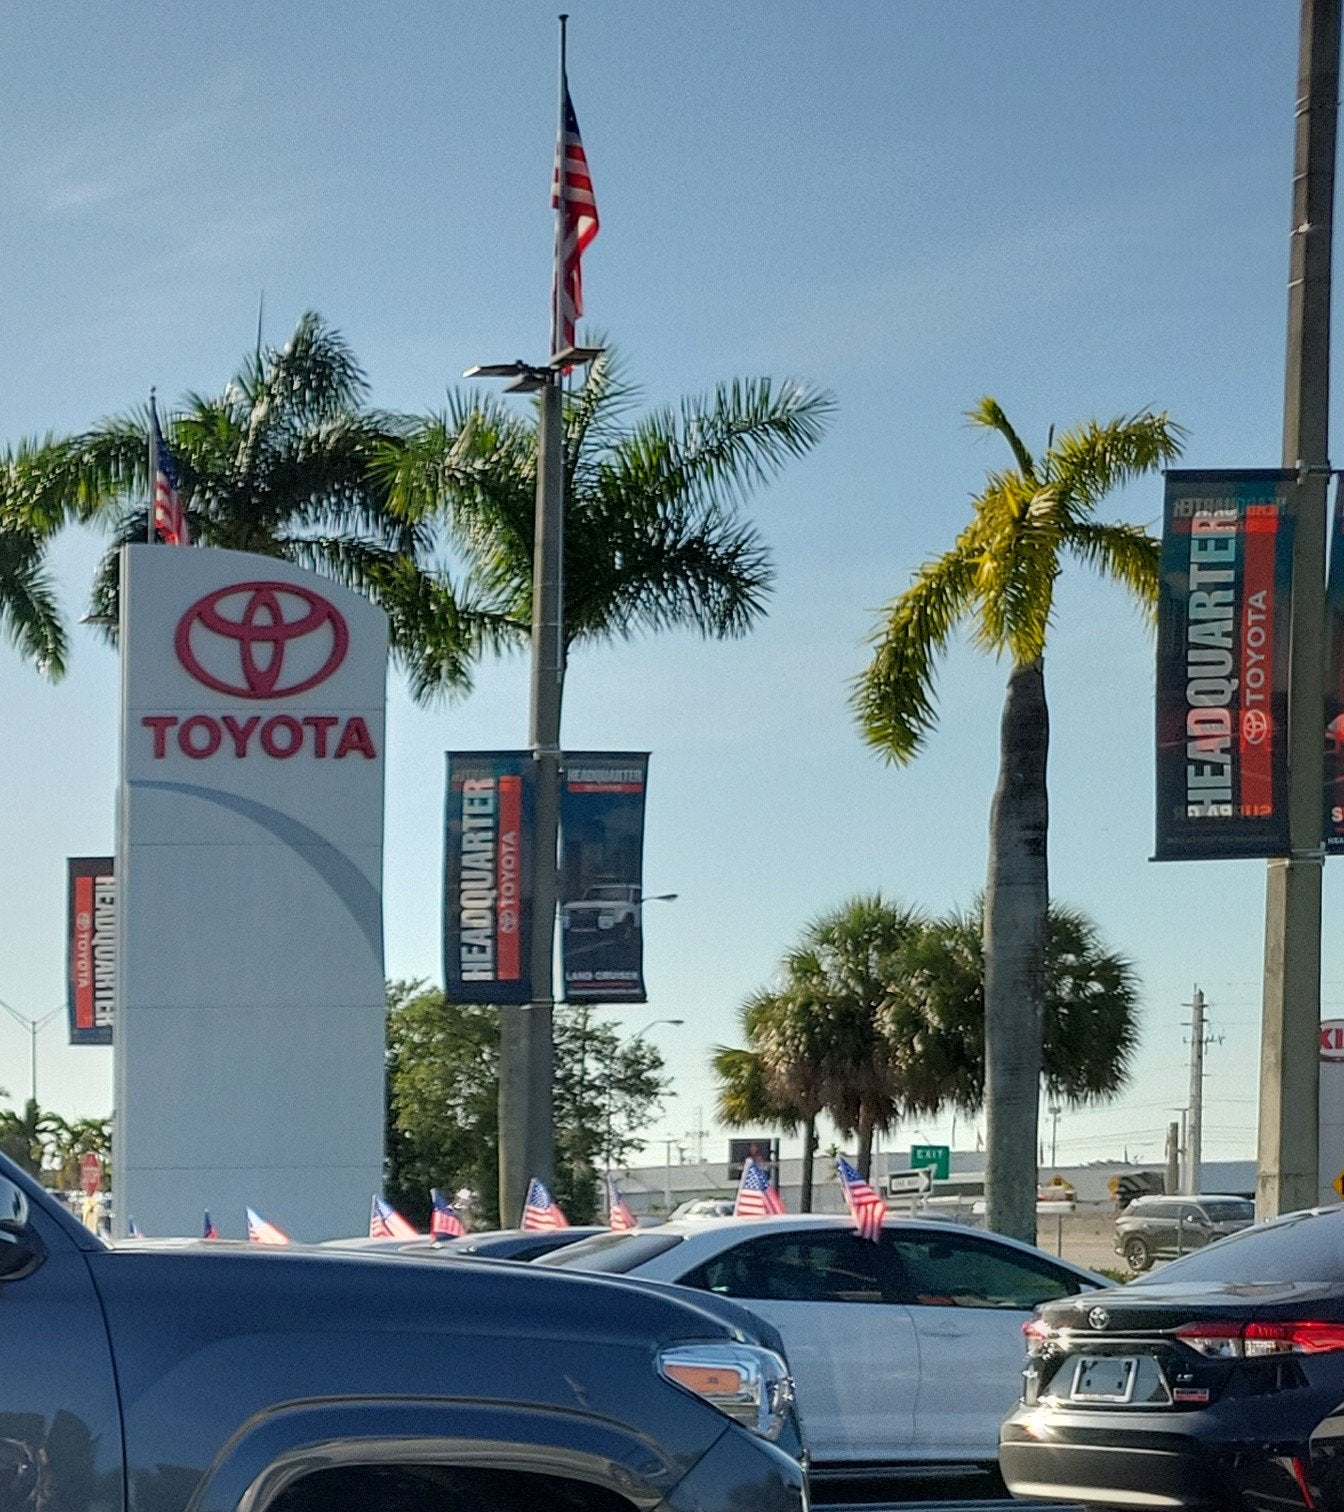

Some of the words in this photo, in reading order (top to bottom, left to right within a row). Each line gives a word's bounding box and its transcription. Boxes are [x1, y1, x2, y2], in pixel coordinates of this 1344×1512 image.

[1187, 508, 1240, 817] HEADQUARTER
[1245, 589, 1267, 704] TOYOTA
[141, 714, 377, 760] TOYOTA
[460, 778, 497, 982] HEADQUARTER
[501, 832, 518, 906] TOYOTA
[916, 1148, 944, 1159] EXIT
